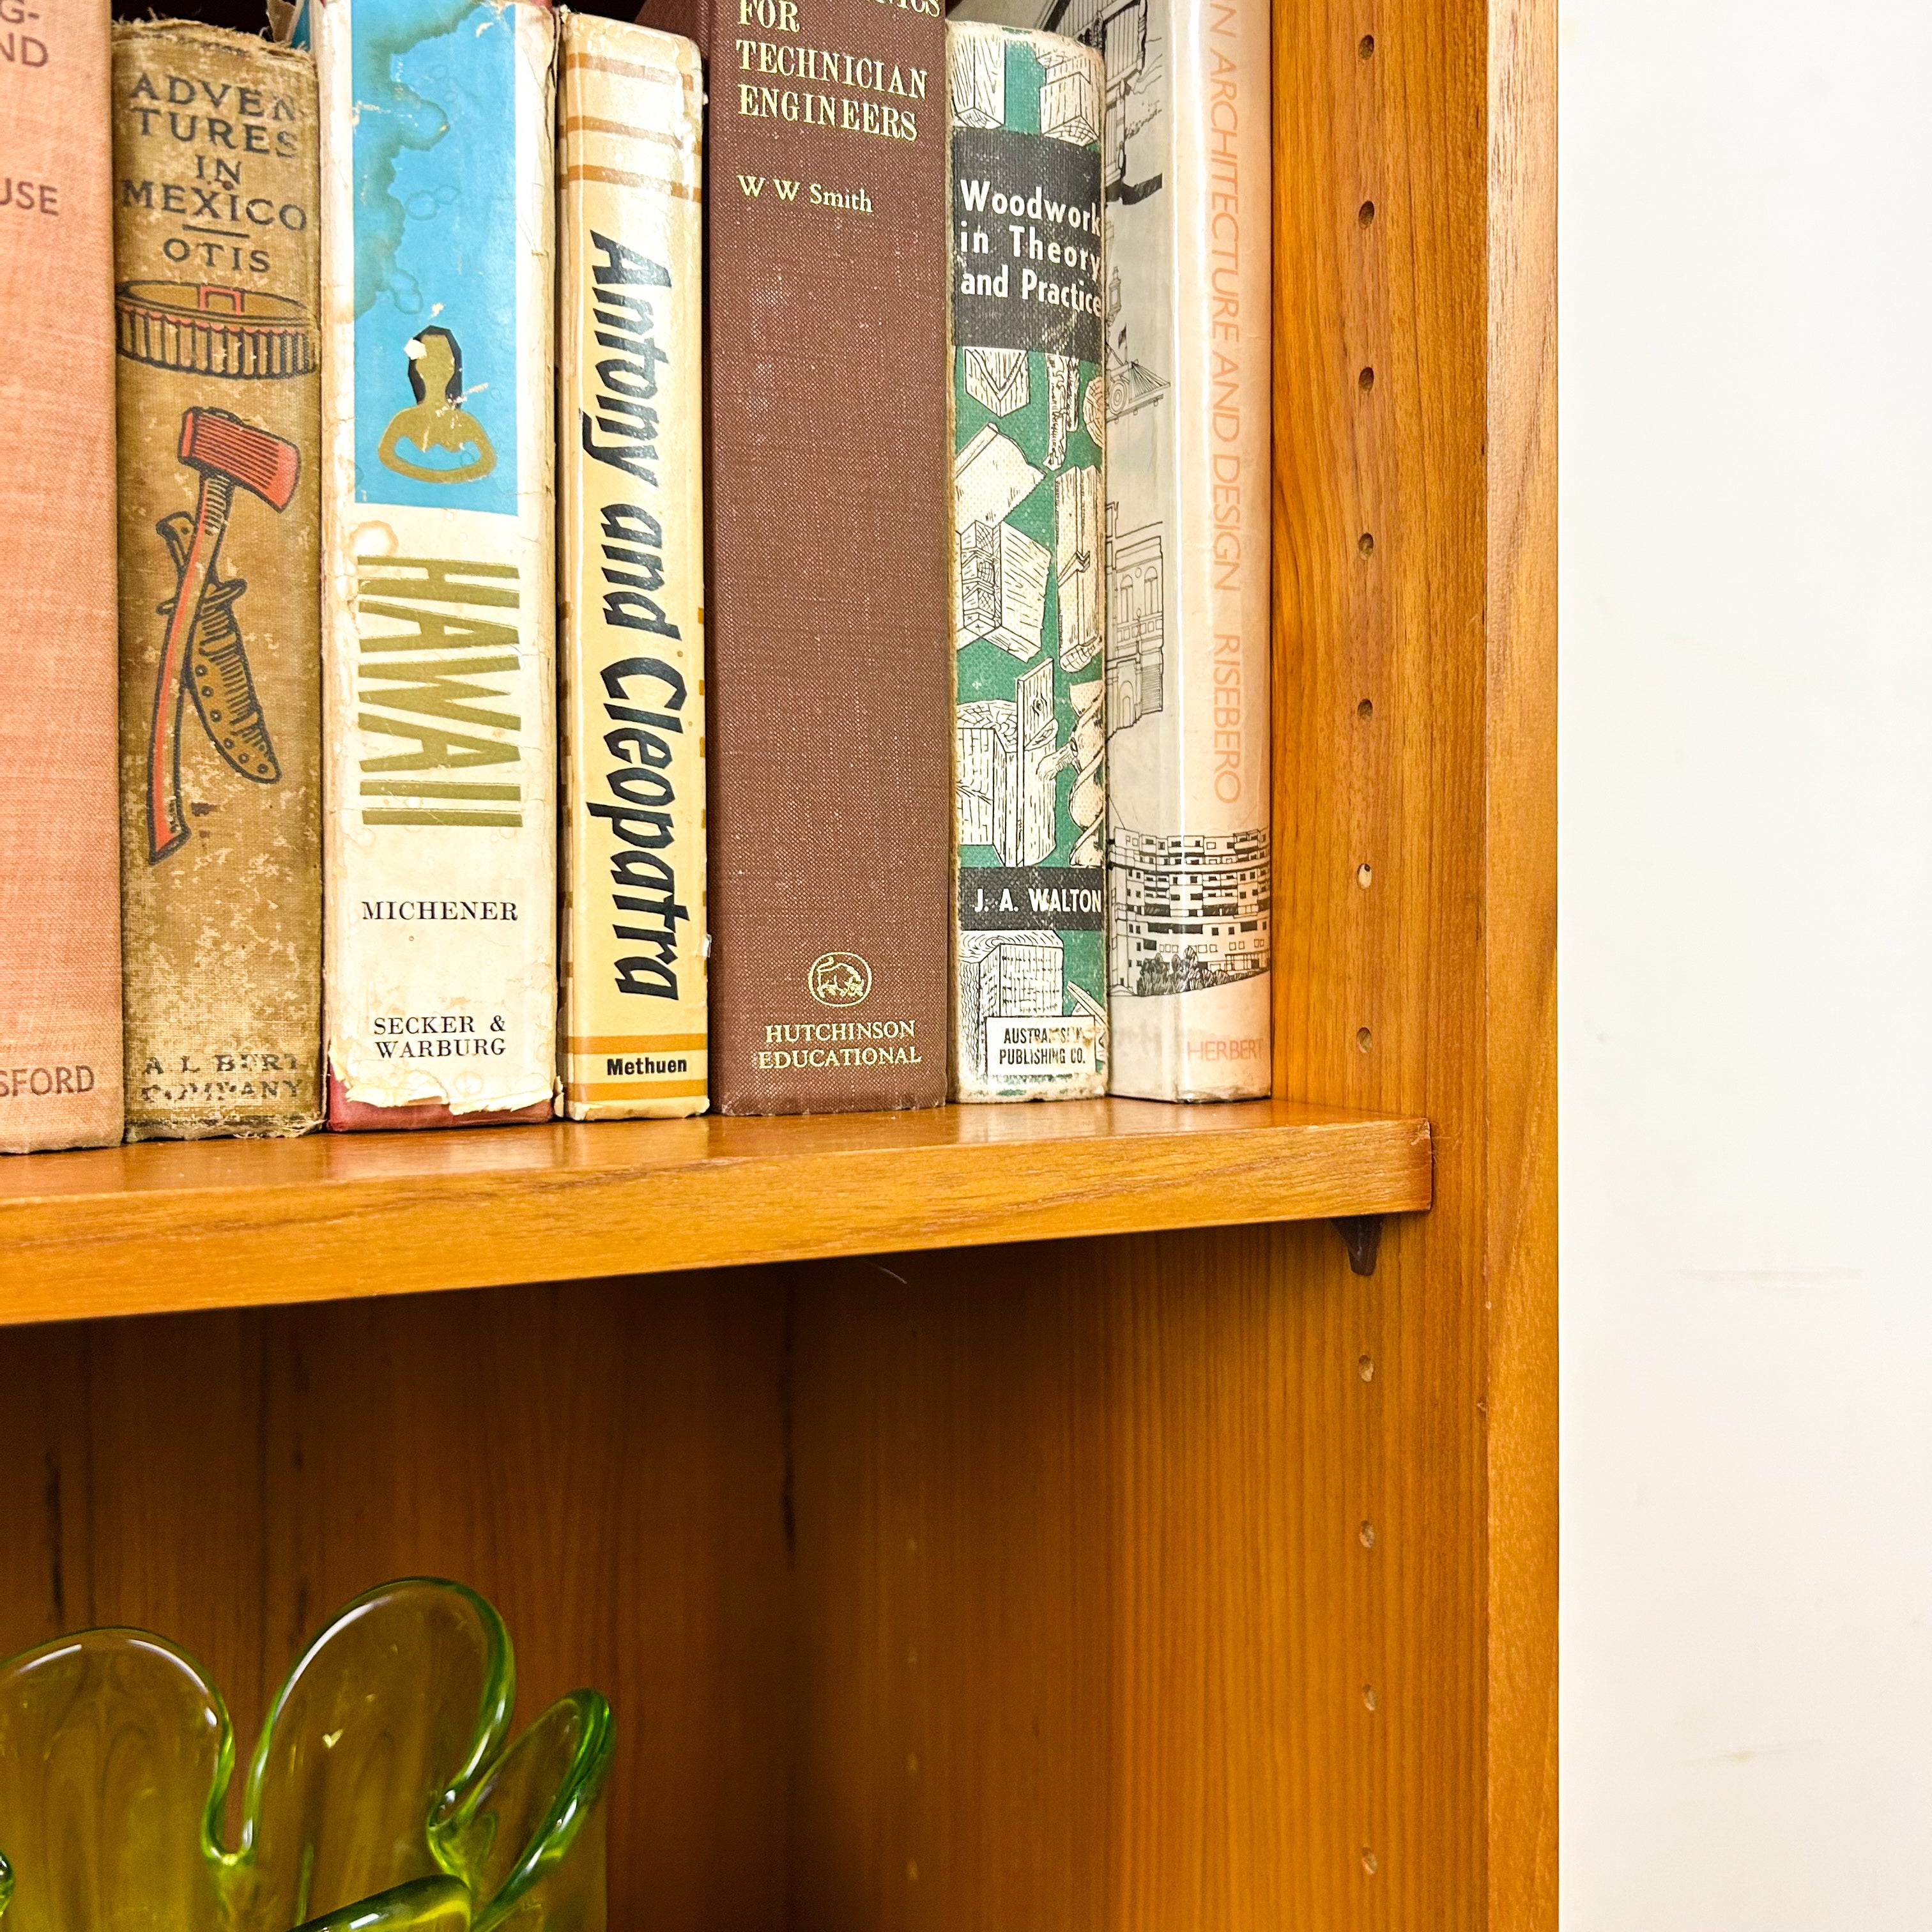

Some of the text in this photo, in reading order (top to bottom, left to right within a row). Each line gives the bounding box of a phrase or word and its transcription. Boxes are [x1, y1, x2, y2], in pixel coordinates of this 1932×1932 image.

[737, 0, 800, 33] FOR
[735, 39, 928, 100] TECHNICIAN
[130, 72, 296, 122] ADVEN
[738, 84, 918, 142] ENGINEERS
[130, 106, 298, 158] TURES
[194, 154, 242, 185] IN
[737, 174, 873, 213] W W Smith
[121, 179, 308, 231] MEXICO
[960, 178, 1101, 237] Woodwork
[1209, 47, 1239, 343] ARCHITECTURE
[163, 238, 271, 273] OTIS
[960, 220, 1101, 282] in Theory
[960, 264, 1103, 318] and Practice
[1211, 350, 1240, 443] AND
[1213, 455, 1241, 592] DESIGN
[578, 229, 690, 1001] Antony and Cleopatra
[357, 554, 523, 828] HAWAII
[1214, 634, 1241, 804] RISEBERO
[362, 901, 518, 921] MICHENER
[974, 887, 1101, 914] J. A. WALTON
[374, 1015, 507, 1035] SECKER &
[374, 1038, 507, 1059] WARBURG
[765, 1020, 916, 1043] HUTCHINSON
[1187, 1038, 1264, 1061] HERBERT
[606, 1056, 687, 1076] Methuen
[758, 1046, 923, 1070] EDUCATIONAL
[999, 1048, 1085, 1064] PUBLISHING CO.
